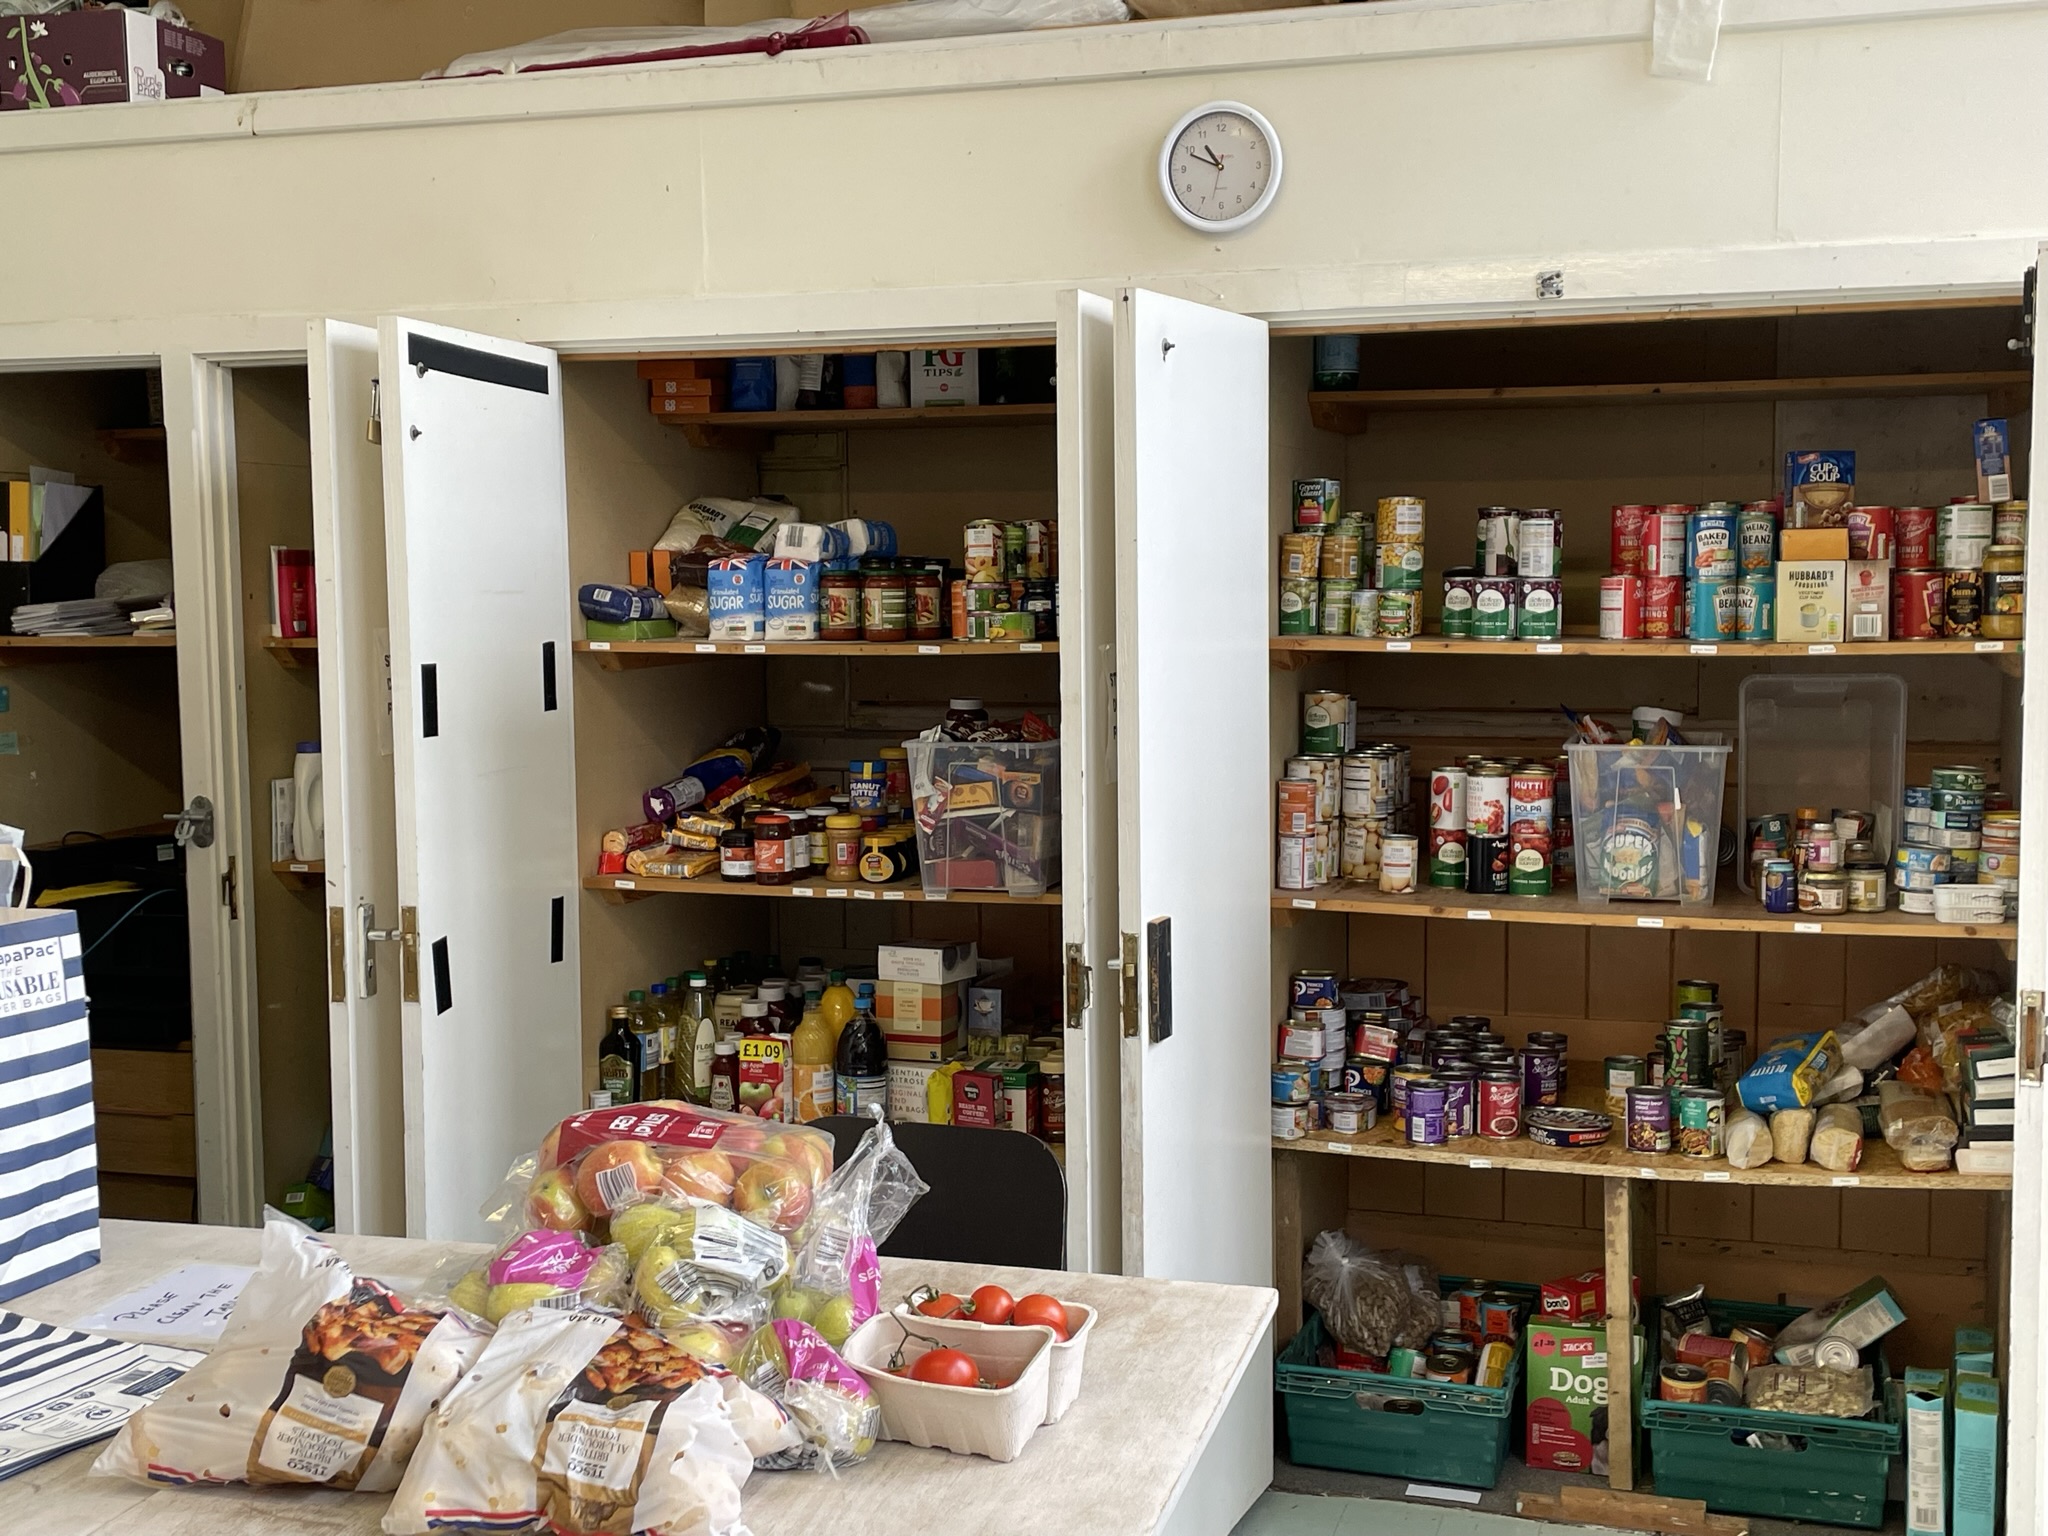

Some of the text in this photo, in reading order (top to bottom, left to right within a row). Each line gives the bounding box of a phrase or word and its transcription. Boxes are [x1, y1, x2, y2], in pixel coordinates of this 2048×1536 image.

[89, 76, 122, 84] EGGPLANTS
[134, 66, 163, 89] Purple
[137, 82, 162, 98] Pride
[1216, 124, 1227, 132] 12
[1185, 146, 1195, 154] 10
[1250, 141, 1256, 150] 2
[1181, 165, 1187, 173] 9
[1256, 161, 1262, 169] 3
[1186, 184, 1192, 192] 8
[1236, 195, 1242, 203] 5
[1218, 202, 1224, 210] 6
[924, 368, 953, 377] TIPS
[1810, 463, 1832, 473] CUP
[1809, 472, 1840, 482] SOUP
[1300, 489, 1323, 497] Giant
[1745, 522, 1769, 532] HEINZ
[1697, 532, 1727, 542] BAKED
[1742, 535, 1771, 545] BEANZ
[1789, 570, 1834, 581] HUBBARD'S
[712, 587, 739, 596] Granulated
[770, 587, 800, 595] Granulated
[1951, 587, 1976, 597] Suma
[709, 595, 744, 610] SUGAR
[767, 595, 804, 610] SUGAR
[1514, 781, 1543, 790] MUTTI
[851, 789, 878, 797] BUTTER
[1955, 794, 1973, 805] JOHN
[1515, 804, 1542, 812] POLPA
[1603, 834, 1655, 856] SUPER
[1603, 857, 1653, 881] NOODLES
[0, 965, 23, 978] THE
[0, 992, 62, 1013] ER BAGS
[743, 1043, 781, 1059] £1.09
[887, 1069, 925, 1078] SENTIAL
[905, 1106, 926, 1114] BAGS
[113, 1291, 179, 1322] PLEASE
[157, 1283, 233, 1324] CLEAN THE
[1562, 1341, 1593, 1352] JACK'S
[1550, 1367, 1609, 1405] Dog
[1566, 1395, 1590, 1405] Adult
[292, 1426, 345, 1449] POTATOES
[571, 1424, 621, 1442] POTATOES
[277, 1431, 327, 1455] ROUNDER
[558, 1432, 630, 1455] ROUNDER ALL
[290, 1447, 332, 1465] BRITISH
[571, 1444, 609, 1462] BRITISH
[287, 1460, 328, 1476] TESCO
[567, 1462, 605, 1480] TESCO
